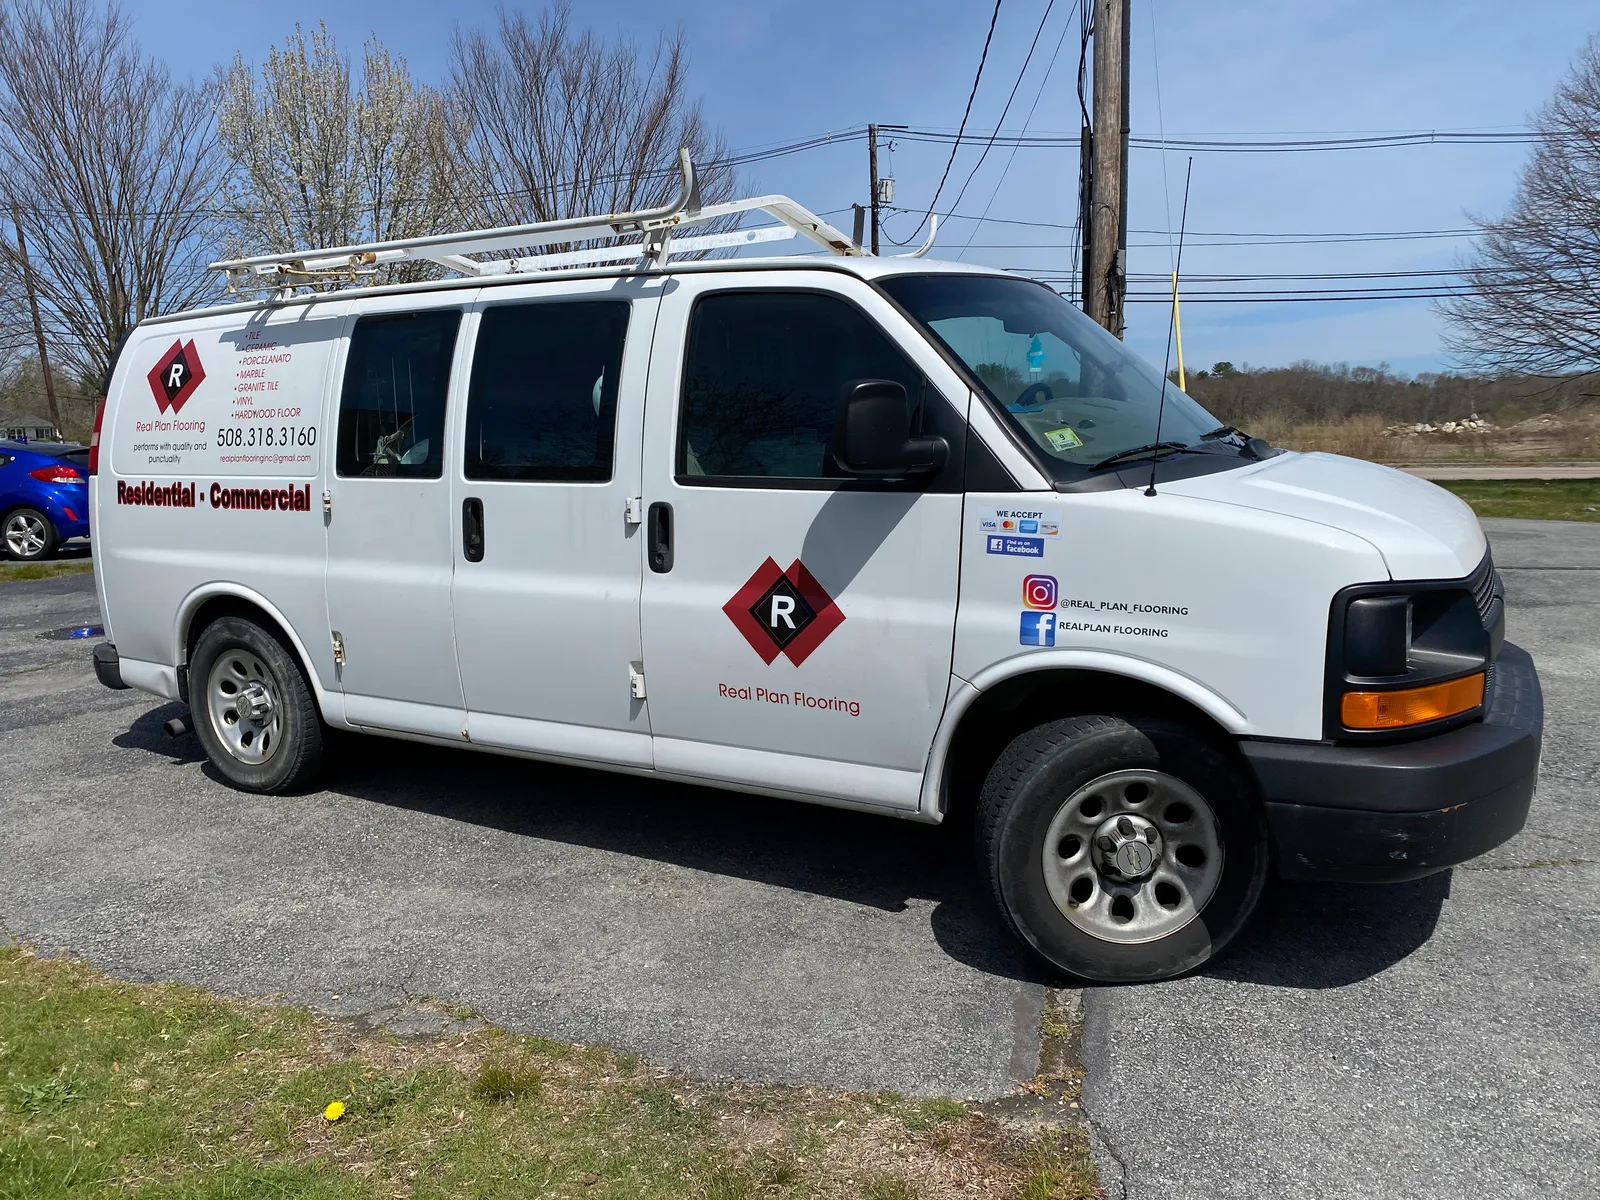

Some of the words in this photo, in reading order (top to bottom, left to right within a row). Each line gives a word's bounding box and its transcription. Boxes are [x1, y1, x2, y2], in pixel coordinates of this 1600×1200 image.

[249, 331, 260, 340] TILE
[246, 342, 277, 353] CERAMIC
[242, 354, 291, 365] PORCELANATO
[168, 363, 183, 387] R
[240, 369, 265, 379] MARBLE
[238, 382, 265, 392] GRANITE
[267, 381, 279, 391] TILE
[236, 396, 253, 405] VINYL
[235, 409, 275, 419] HARDWOOD
[277, 408, 301, 417] FLOOR
[136, 421, 153, 432] Real
[154, 421, 172, 431] Plan
[173, 420, 205, 433] Flooring
[217, 427, 316, 446] 508.318.3160
[133, 443, 159, 452] performs
[159, 442, 172, 450] with
[172, 442, 193, 452] quality
[194, 442, 207, 450] and
[148, 455, 181, 464] punctuality
[117, 480, 195, 508] Residential
[210, 482, 311, 511] Commercial
[1010, 511, 1043, 519] ACCEPT
[1006, 545, 1039, 554] facebook
[771, 595, 797, 629] R
[1060, 599, 1188, 616] @REAL_PLAN_FLOORING
[1059, 621, 1111, 633] REALPLAN
[1113, 625, 1168, 638] FLOORING
[718, 683, 752, 700] Real
[756, 687, 789, 705] Plan
[794, 692, 860, 717] Flooring
